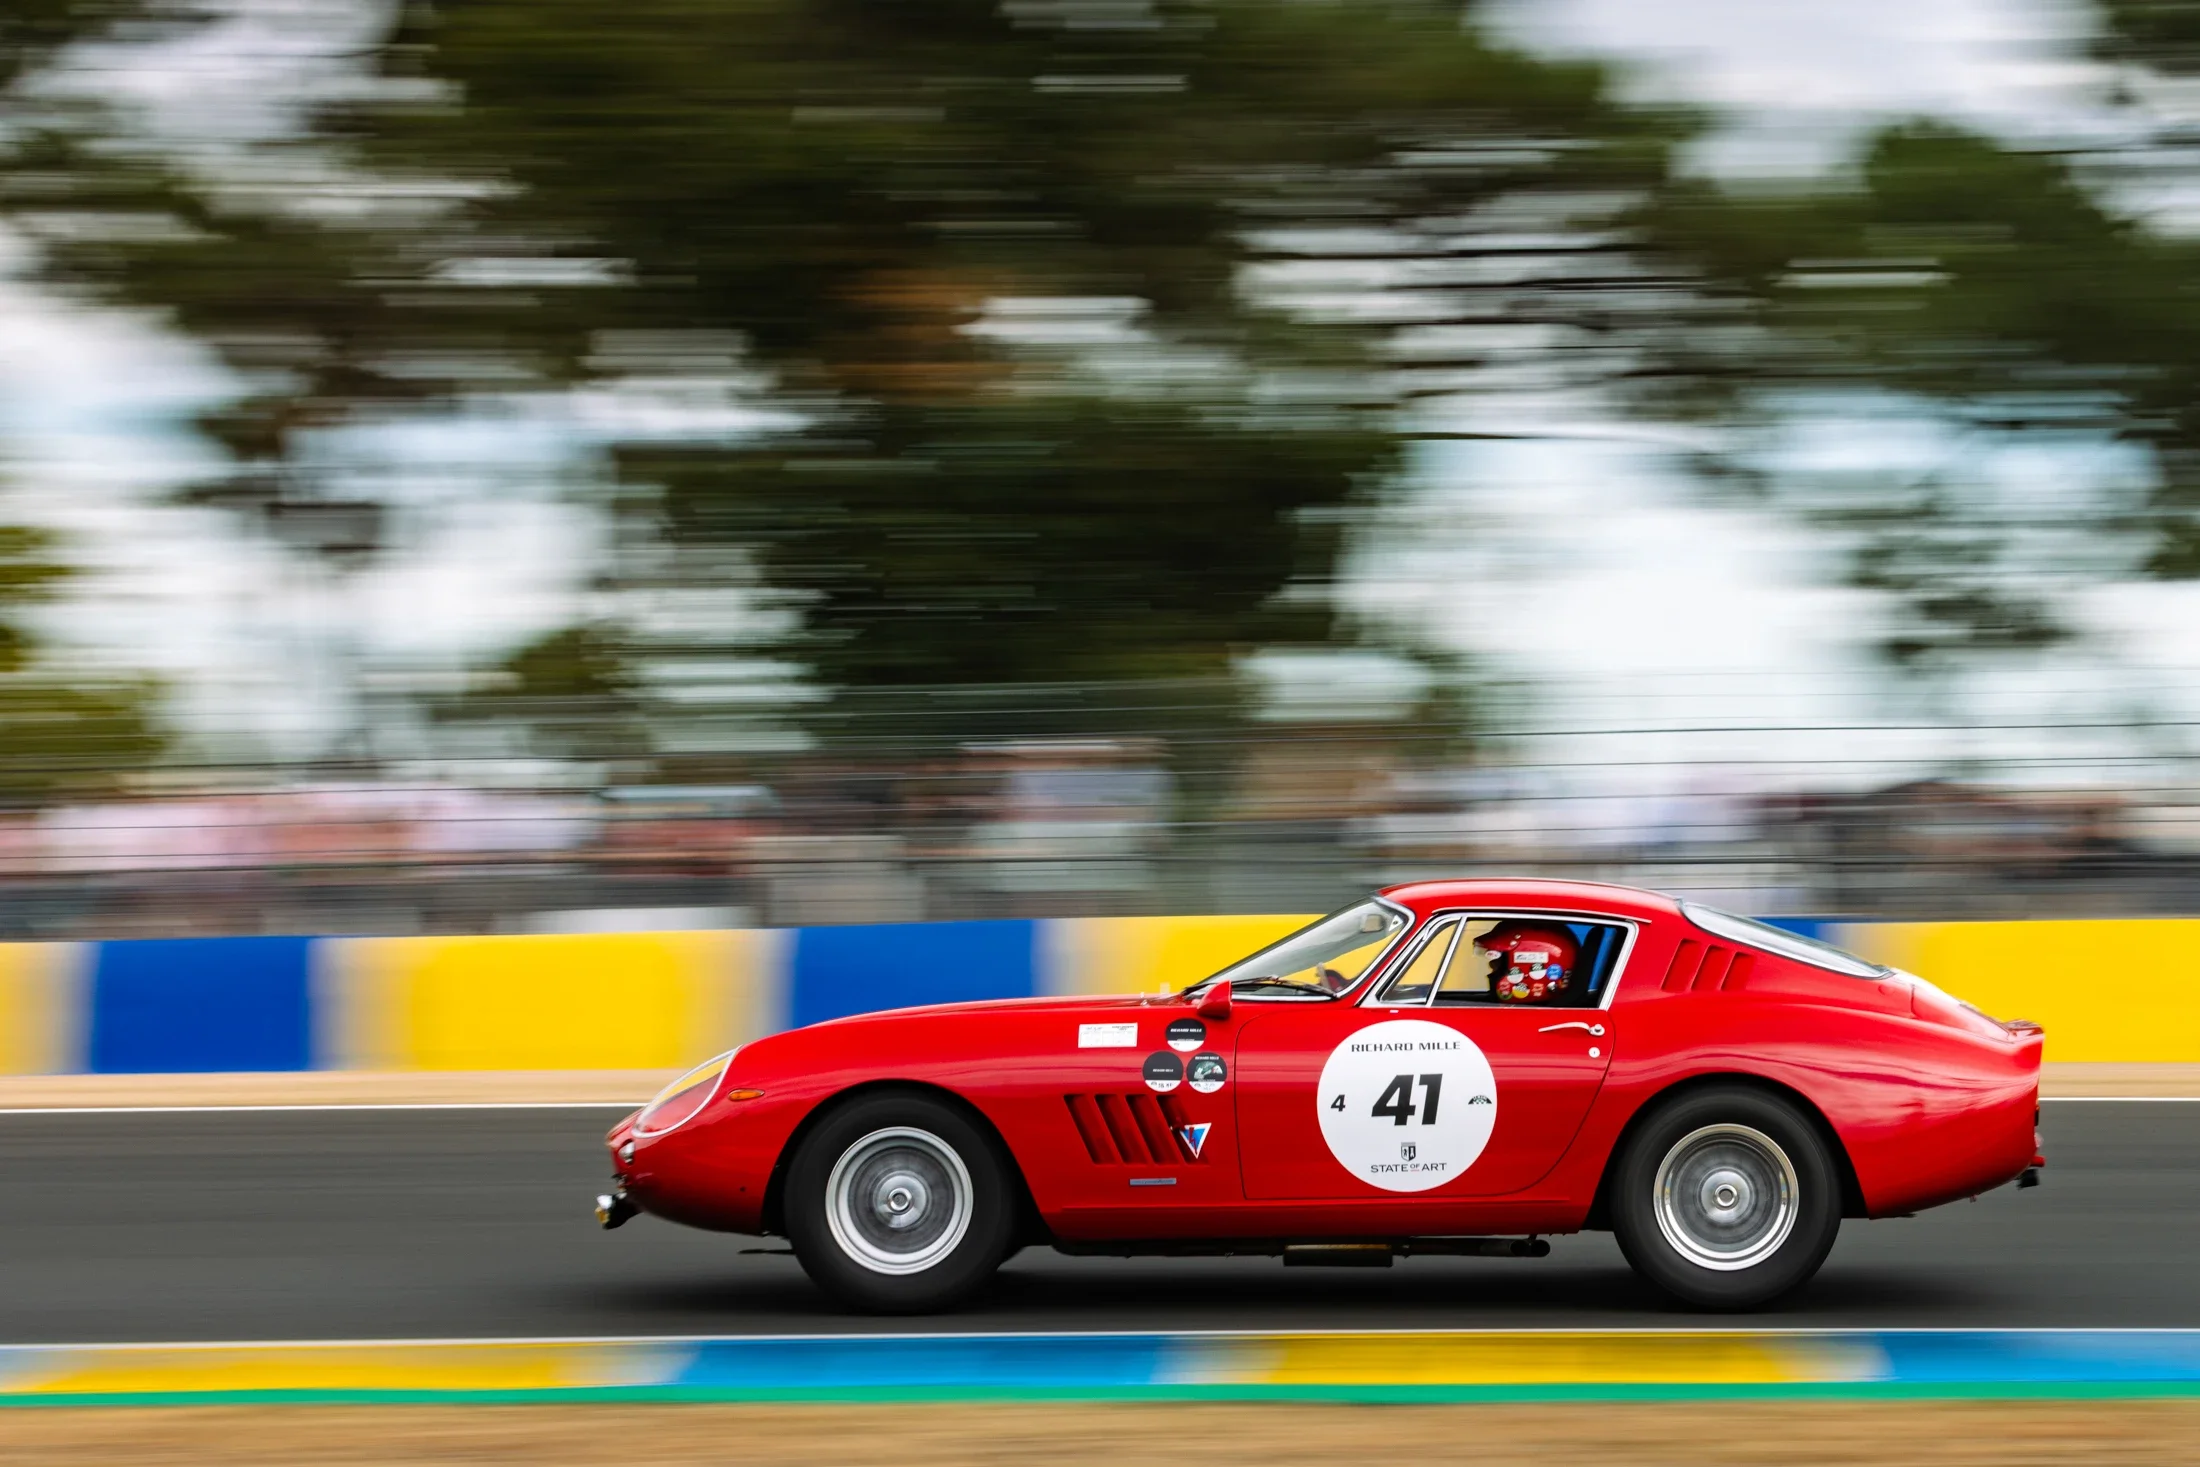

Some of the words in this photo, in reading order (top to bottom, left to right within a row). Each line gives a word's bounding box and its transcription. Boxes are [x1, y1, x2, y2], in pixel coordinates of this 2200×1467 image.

[1351, 1043, 1413, 1053] RICHARD
[1418, 1041, 1460, 1051] MILLE
[1330, 1094, 1346, 1112] 4
[1371, 1073, 1443, 1126] 41
[1370, 1164, 1408, 1173] STATE
[1421, 1162, 1447, 1171] ART
